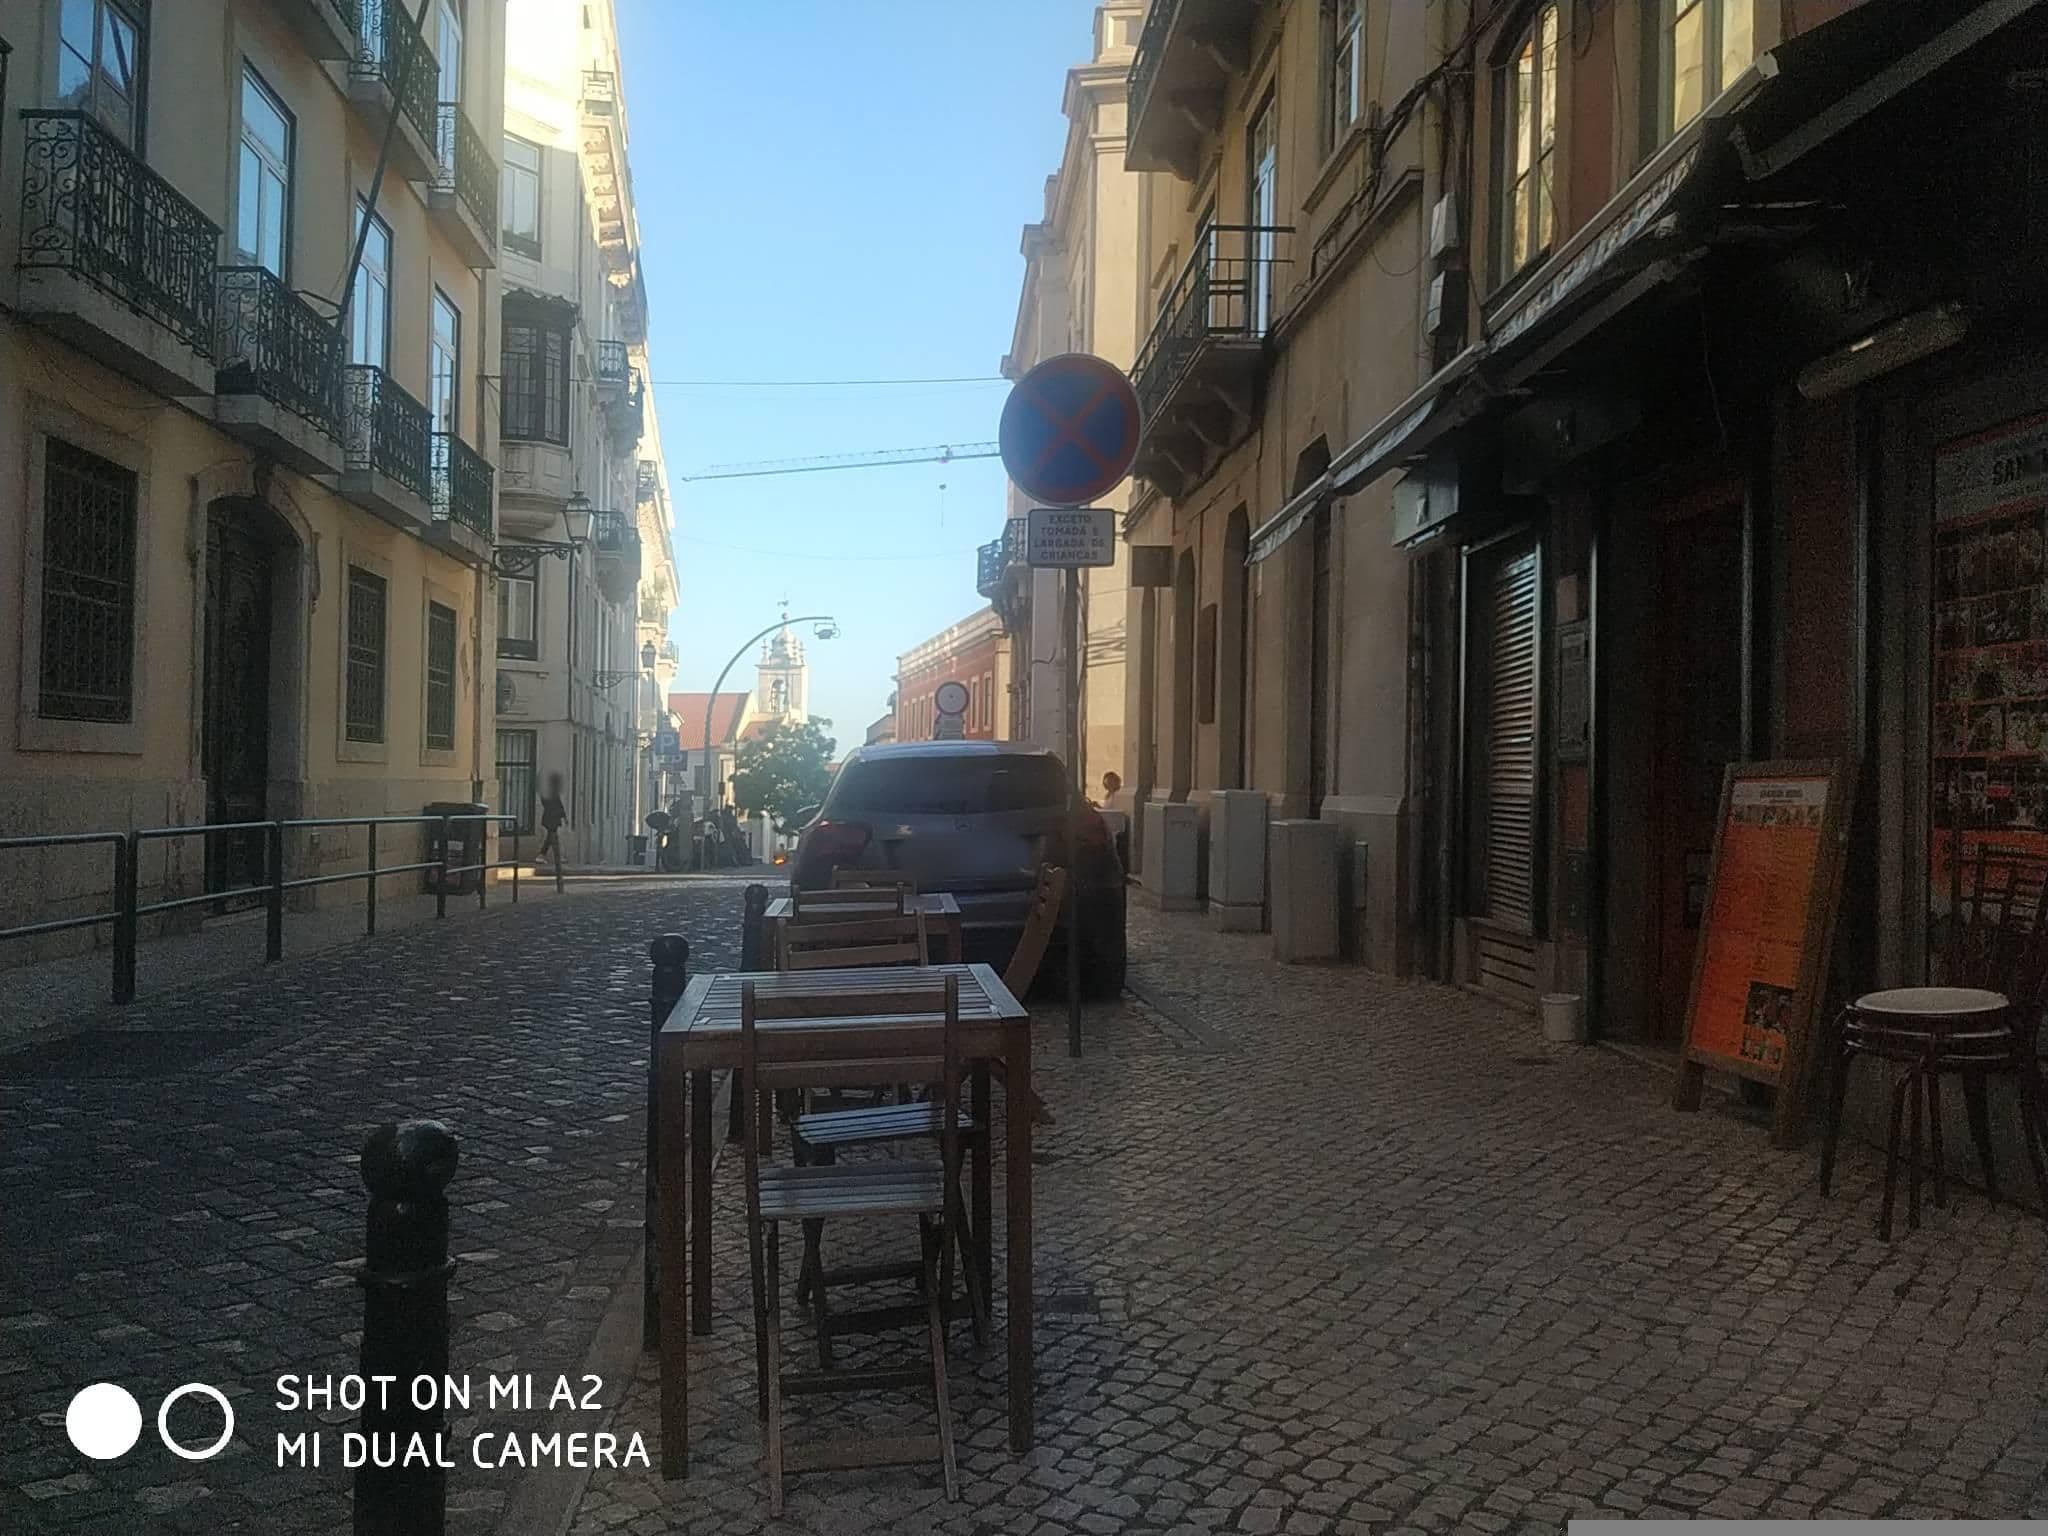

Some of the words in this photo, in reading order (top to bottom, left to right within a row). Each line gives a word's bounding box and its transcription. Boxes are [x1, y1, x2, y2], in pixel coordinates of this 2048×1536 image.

[1049, 514, 1091, 525] EXCETO
[1041, 526, 1086, 537] TOMADA
[1034, 538, 1085, 548] LARGADA
[1091, 538, 1104, 548] DE
[660, 734, 674, 753] P
